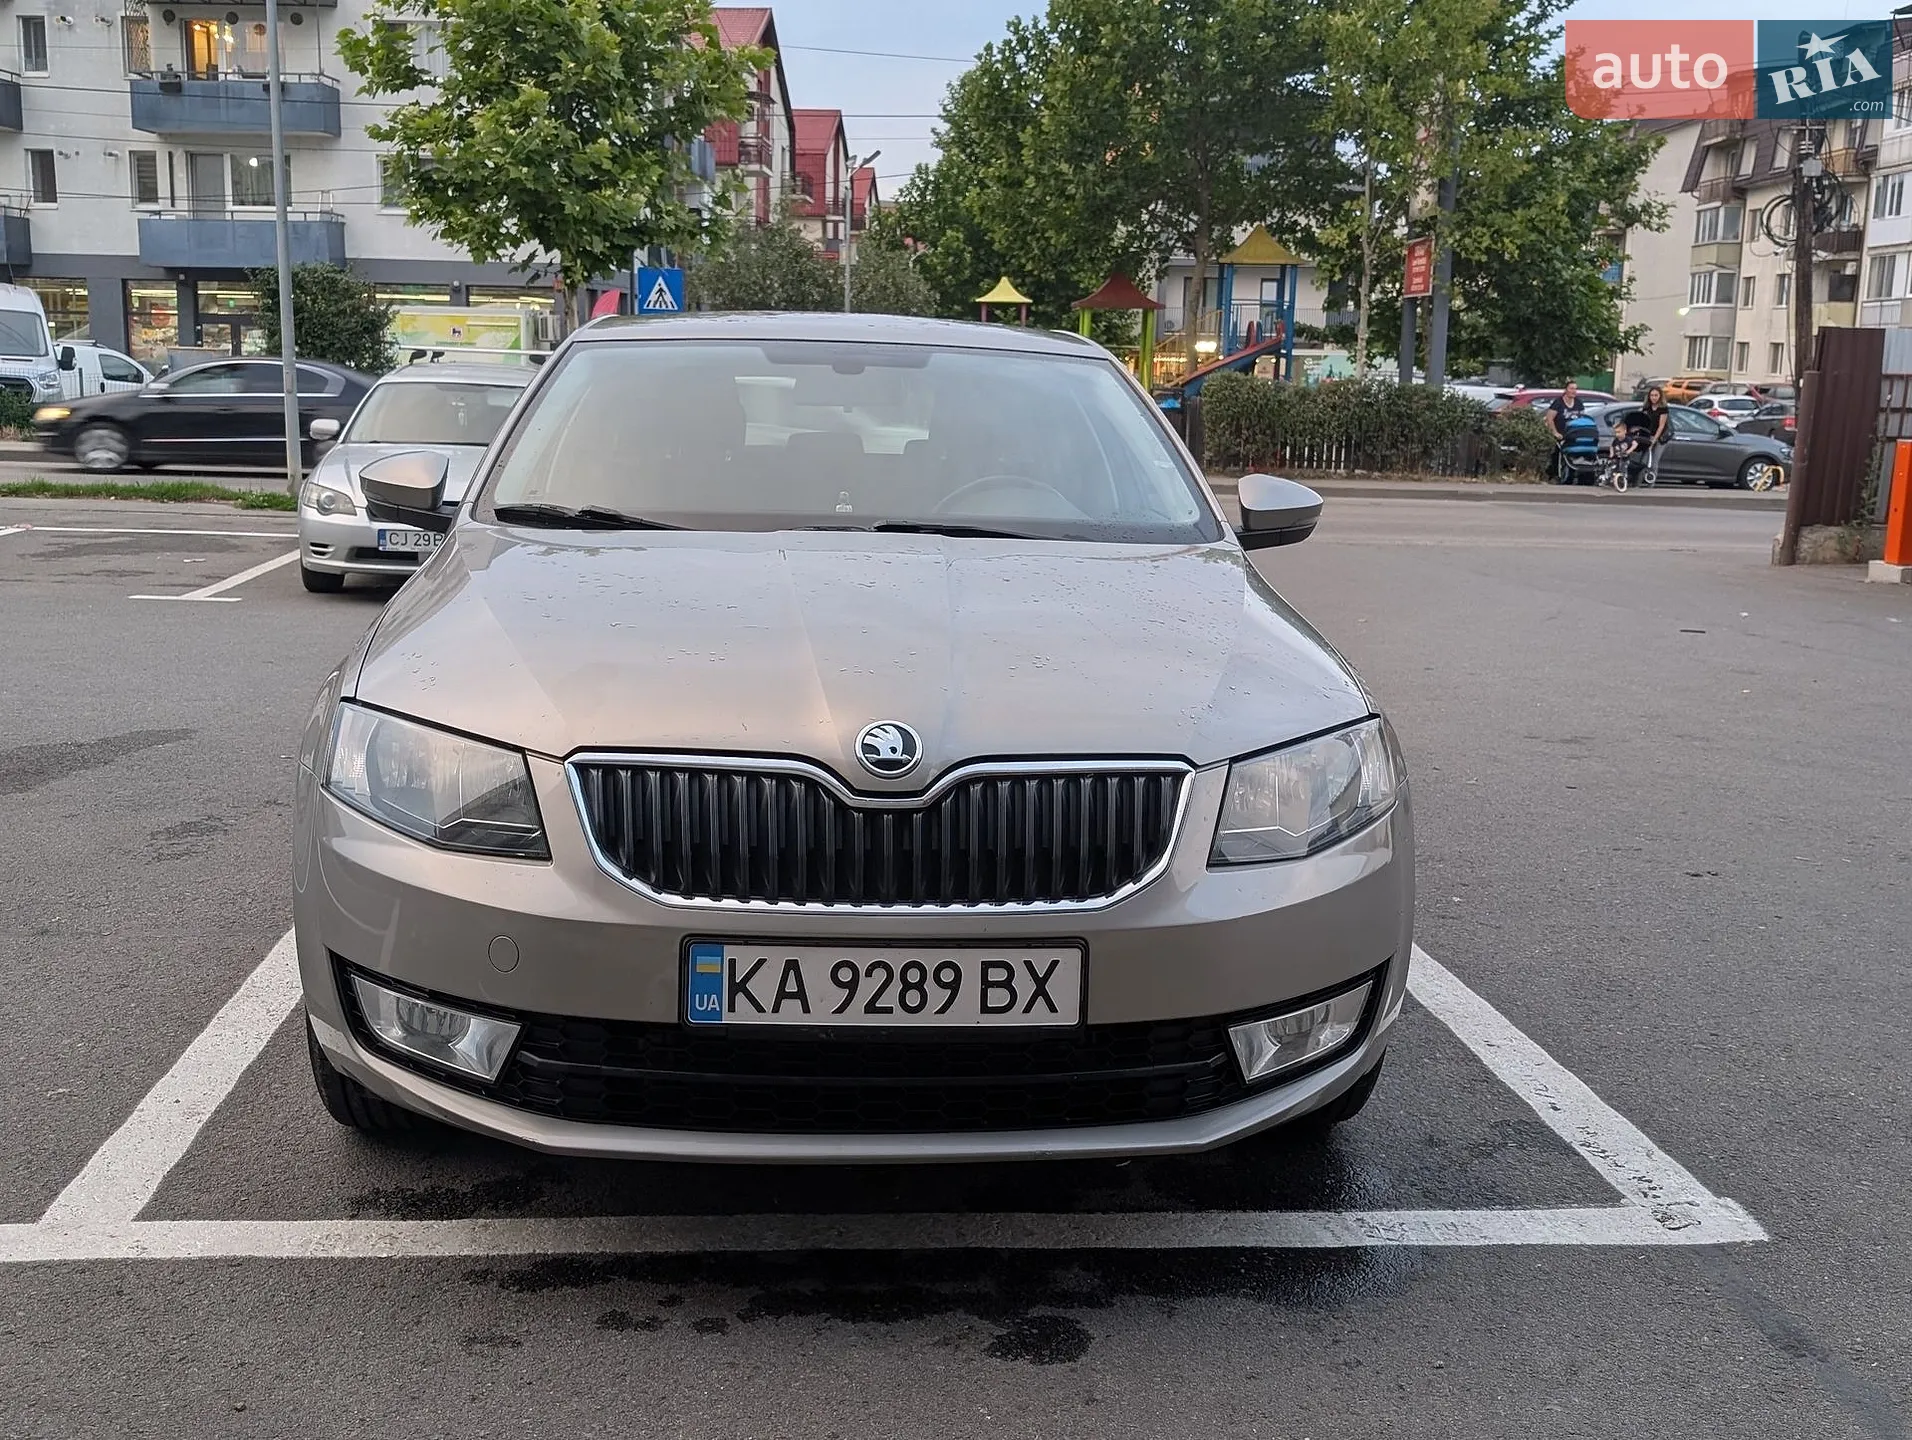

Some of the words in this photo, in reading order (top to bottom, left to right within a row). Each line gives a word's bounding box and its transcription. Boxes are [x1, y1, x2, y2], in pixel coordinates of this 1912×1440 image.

[389, 532, 408, 546] CJ
[726, 957, 811, 1015] KA
[829, 959, 963, 1016] 9289
[978, 959, 1061, 1015] BX
[695, 994, 720, 1011] UA
